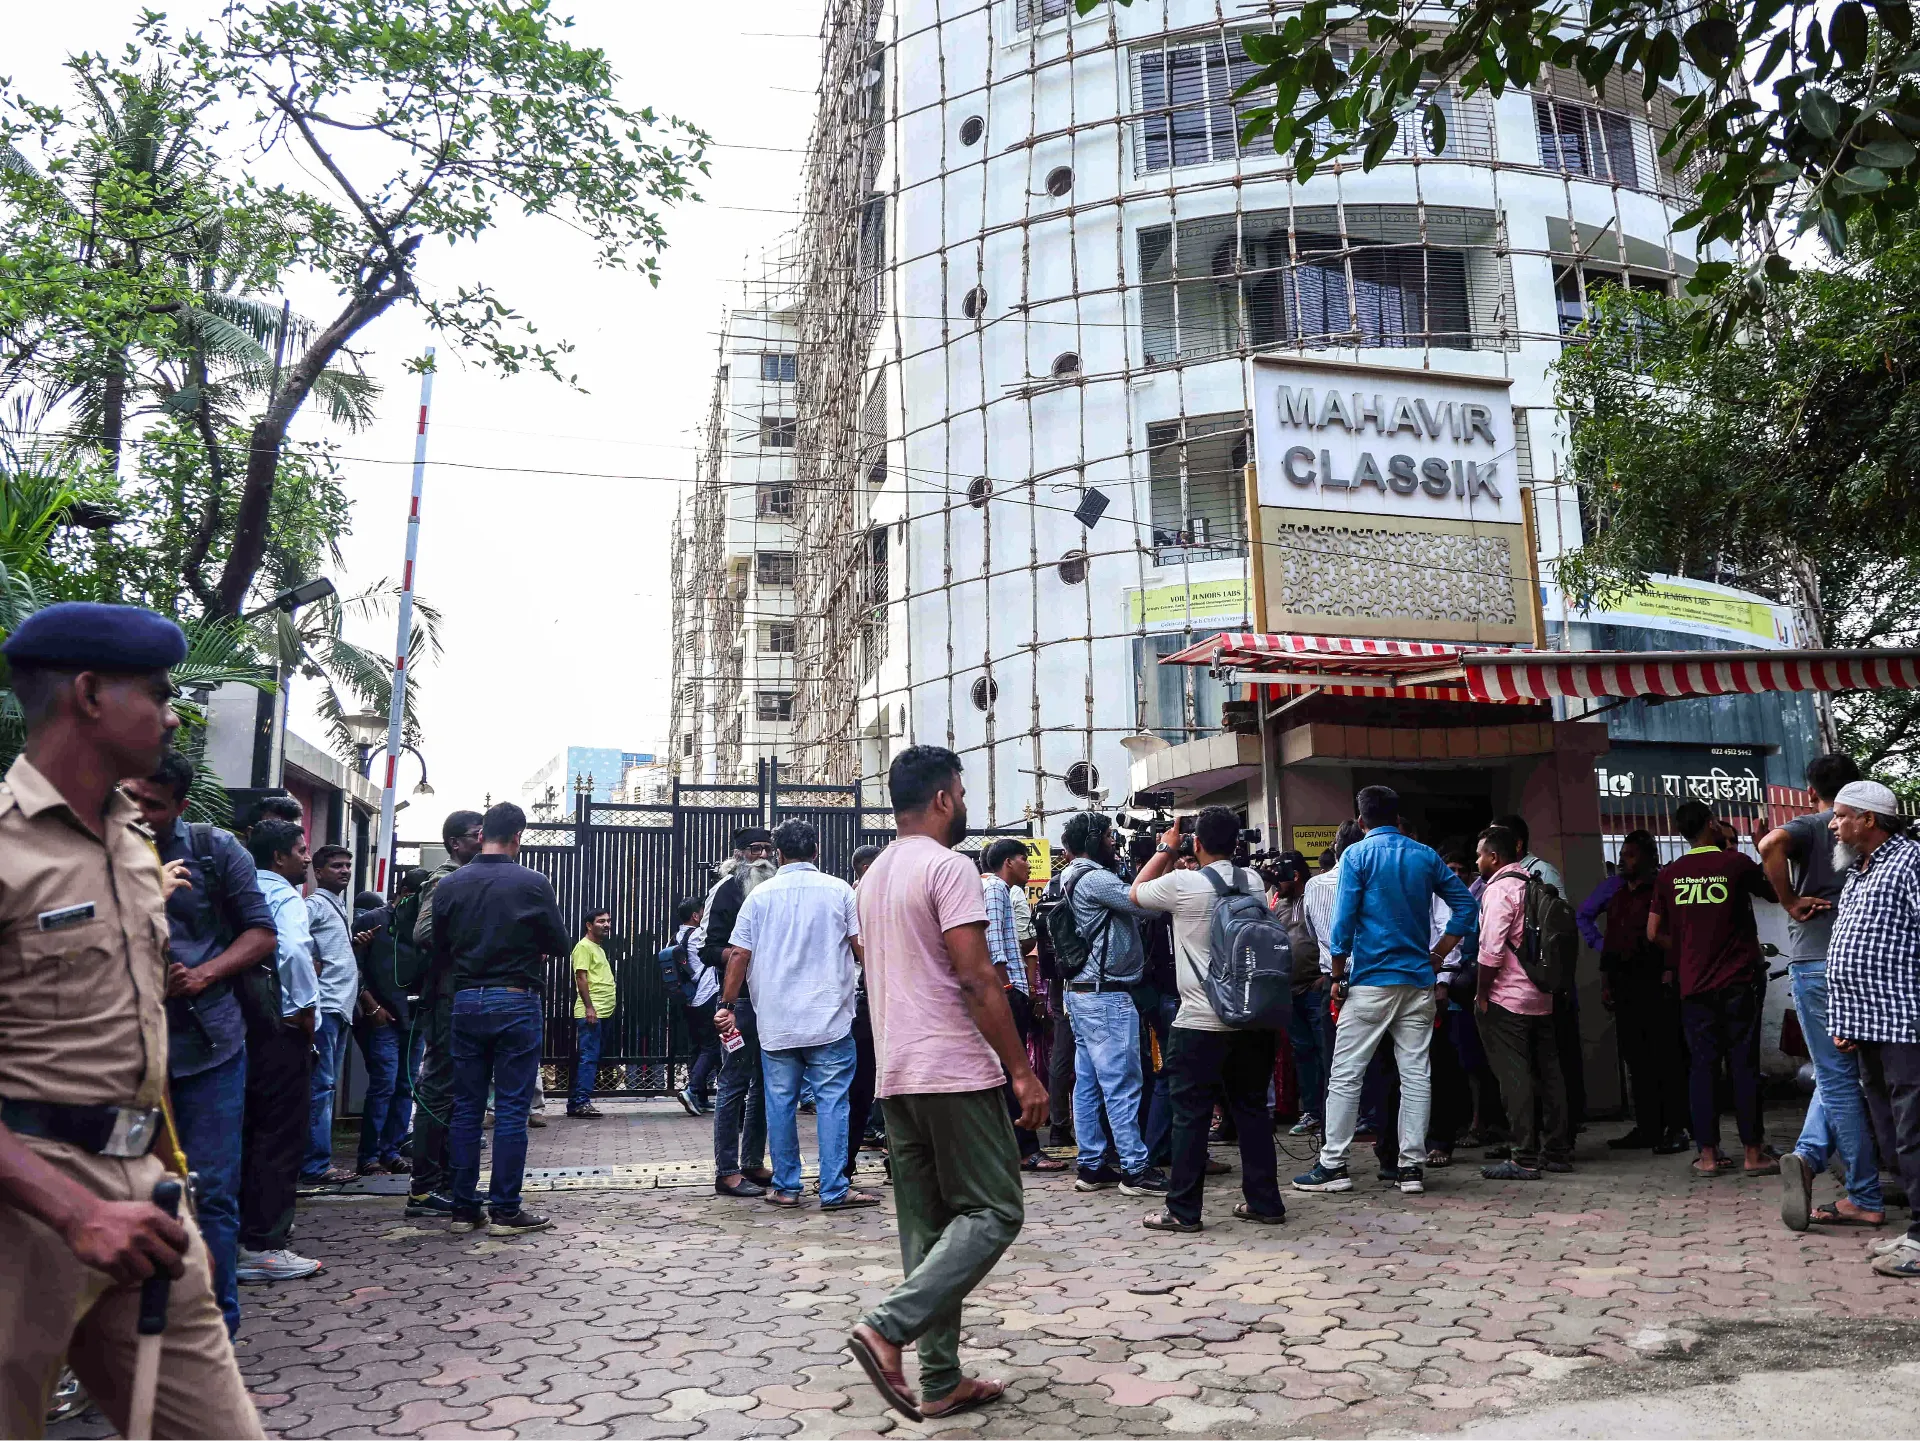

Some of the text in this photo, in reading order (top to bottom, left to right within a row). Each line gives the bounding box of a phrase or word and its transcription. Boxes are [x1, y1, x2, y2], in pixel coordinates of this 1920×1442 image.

[1278, 385, 1496, 444] MAHAVIR
[1282, 446, 1503, 500] CLASSIK
[1170, 590, 1241, 603] VOIL JUNIORS LABS
[1661, 773, 1682, 799] रा
[1295, 830, 1337, 839] GUEST/VISITO
[1685, 876, 1708, 884] Ready
[1708, 875, 1728, 883] With
[1674, 883, 1728, 905] ZILO
